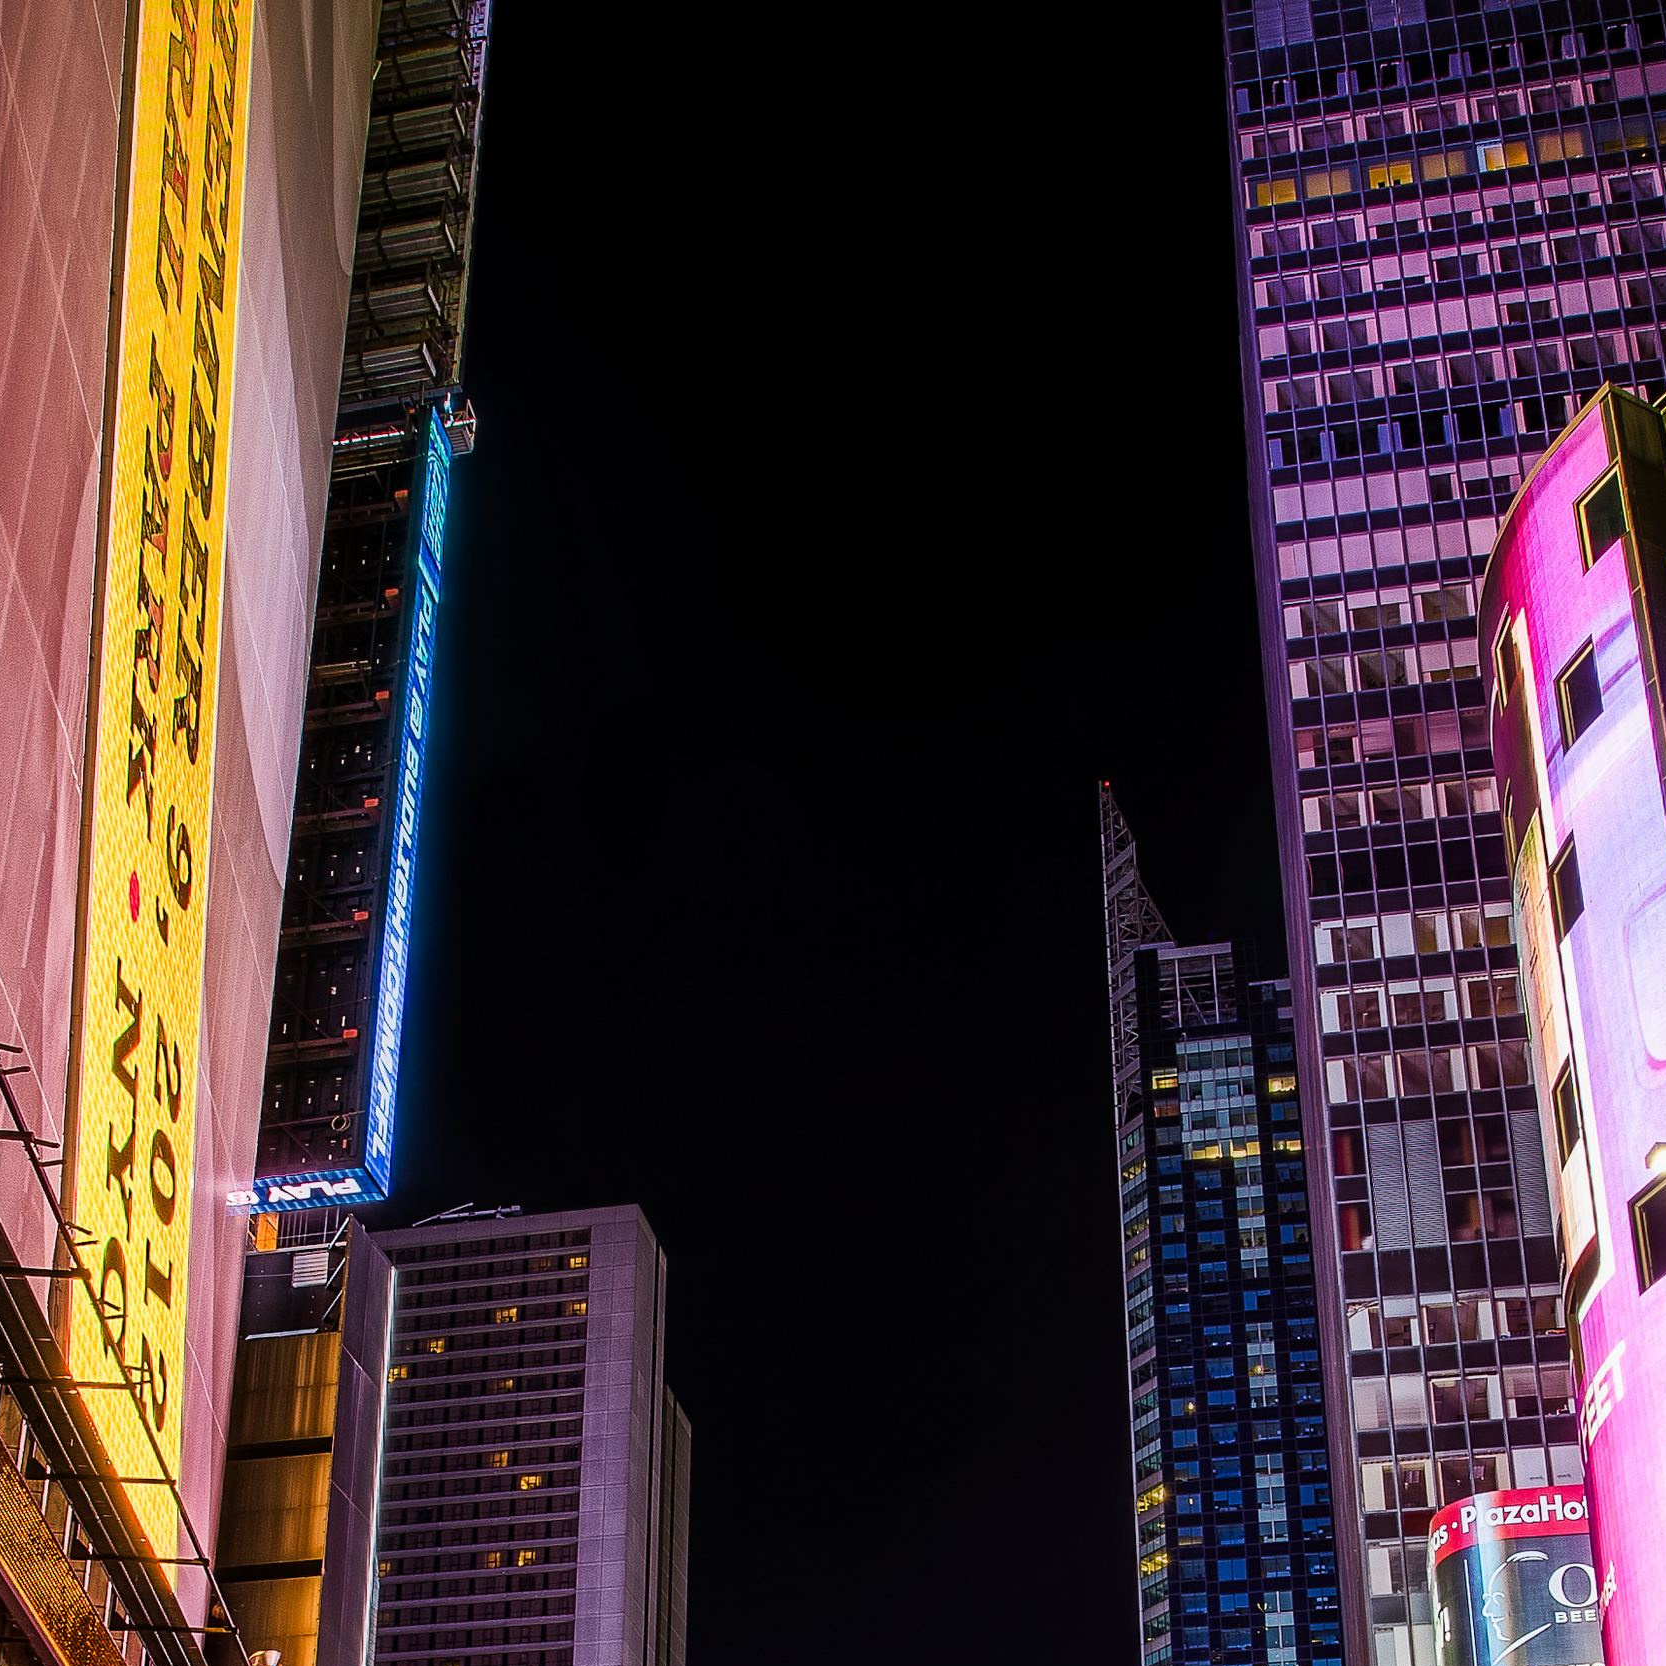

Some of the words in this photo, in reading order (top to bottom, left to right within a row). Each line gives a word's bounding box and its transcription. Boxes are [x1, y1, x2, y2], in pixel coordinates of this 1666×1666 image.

[157, 0, 199, 313] RAL
[128, 334, 174, 838] PARK
[174, 0, 239, 764] TEMBER
[414, 600, 433, 690] PLAY
[157, 805, 191, 944] 9,
[366, 742, 419, 1158] BUDLIGHT.COM/FFL
[103, 956, 141, 1364] NYC
[135, 1014, 181, 1432] 2012
